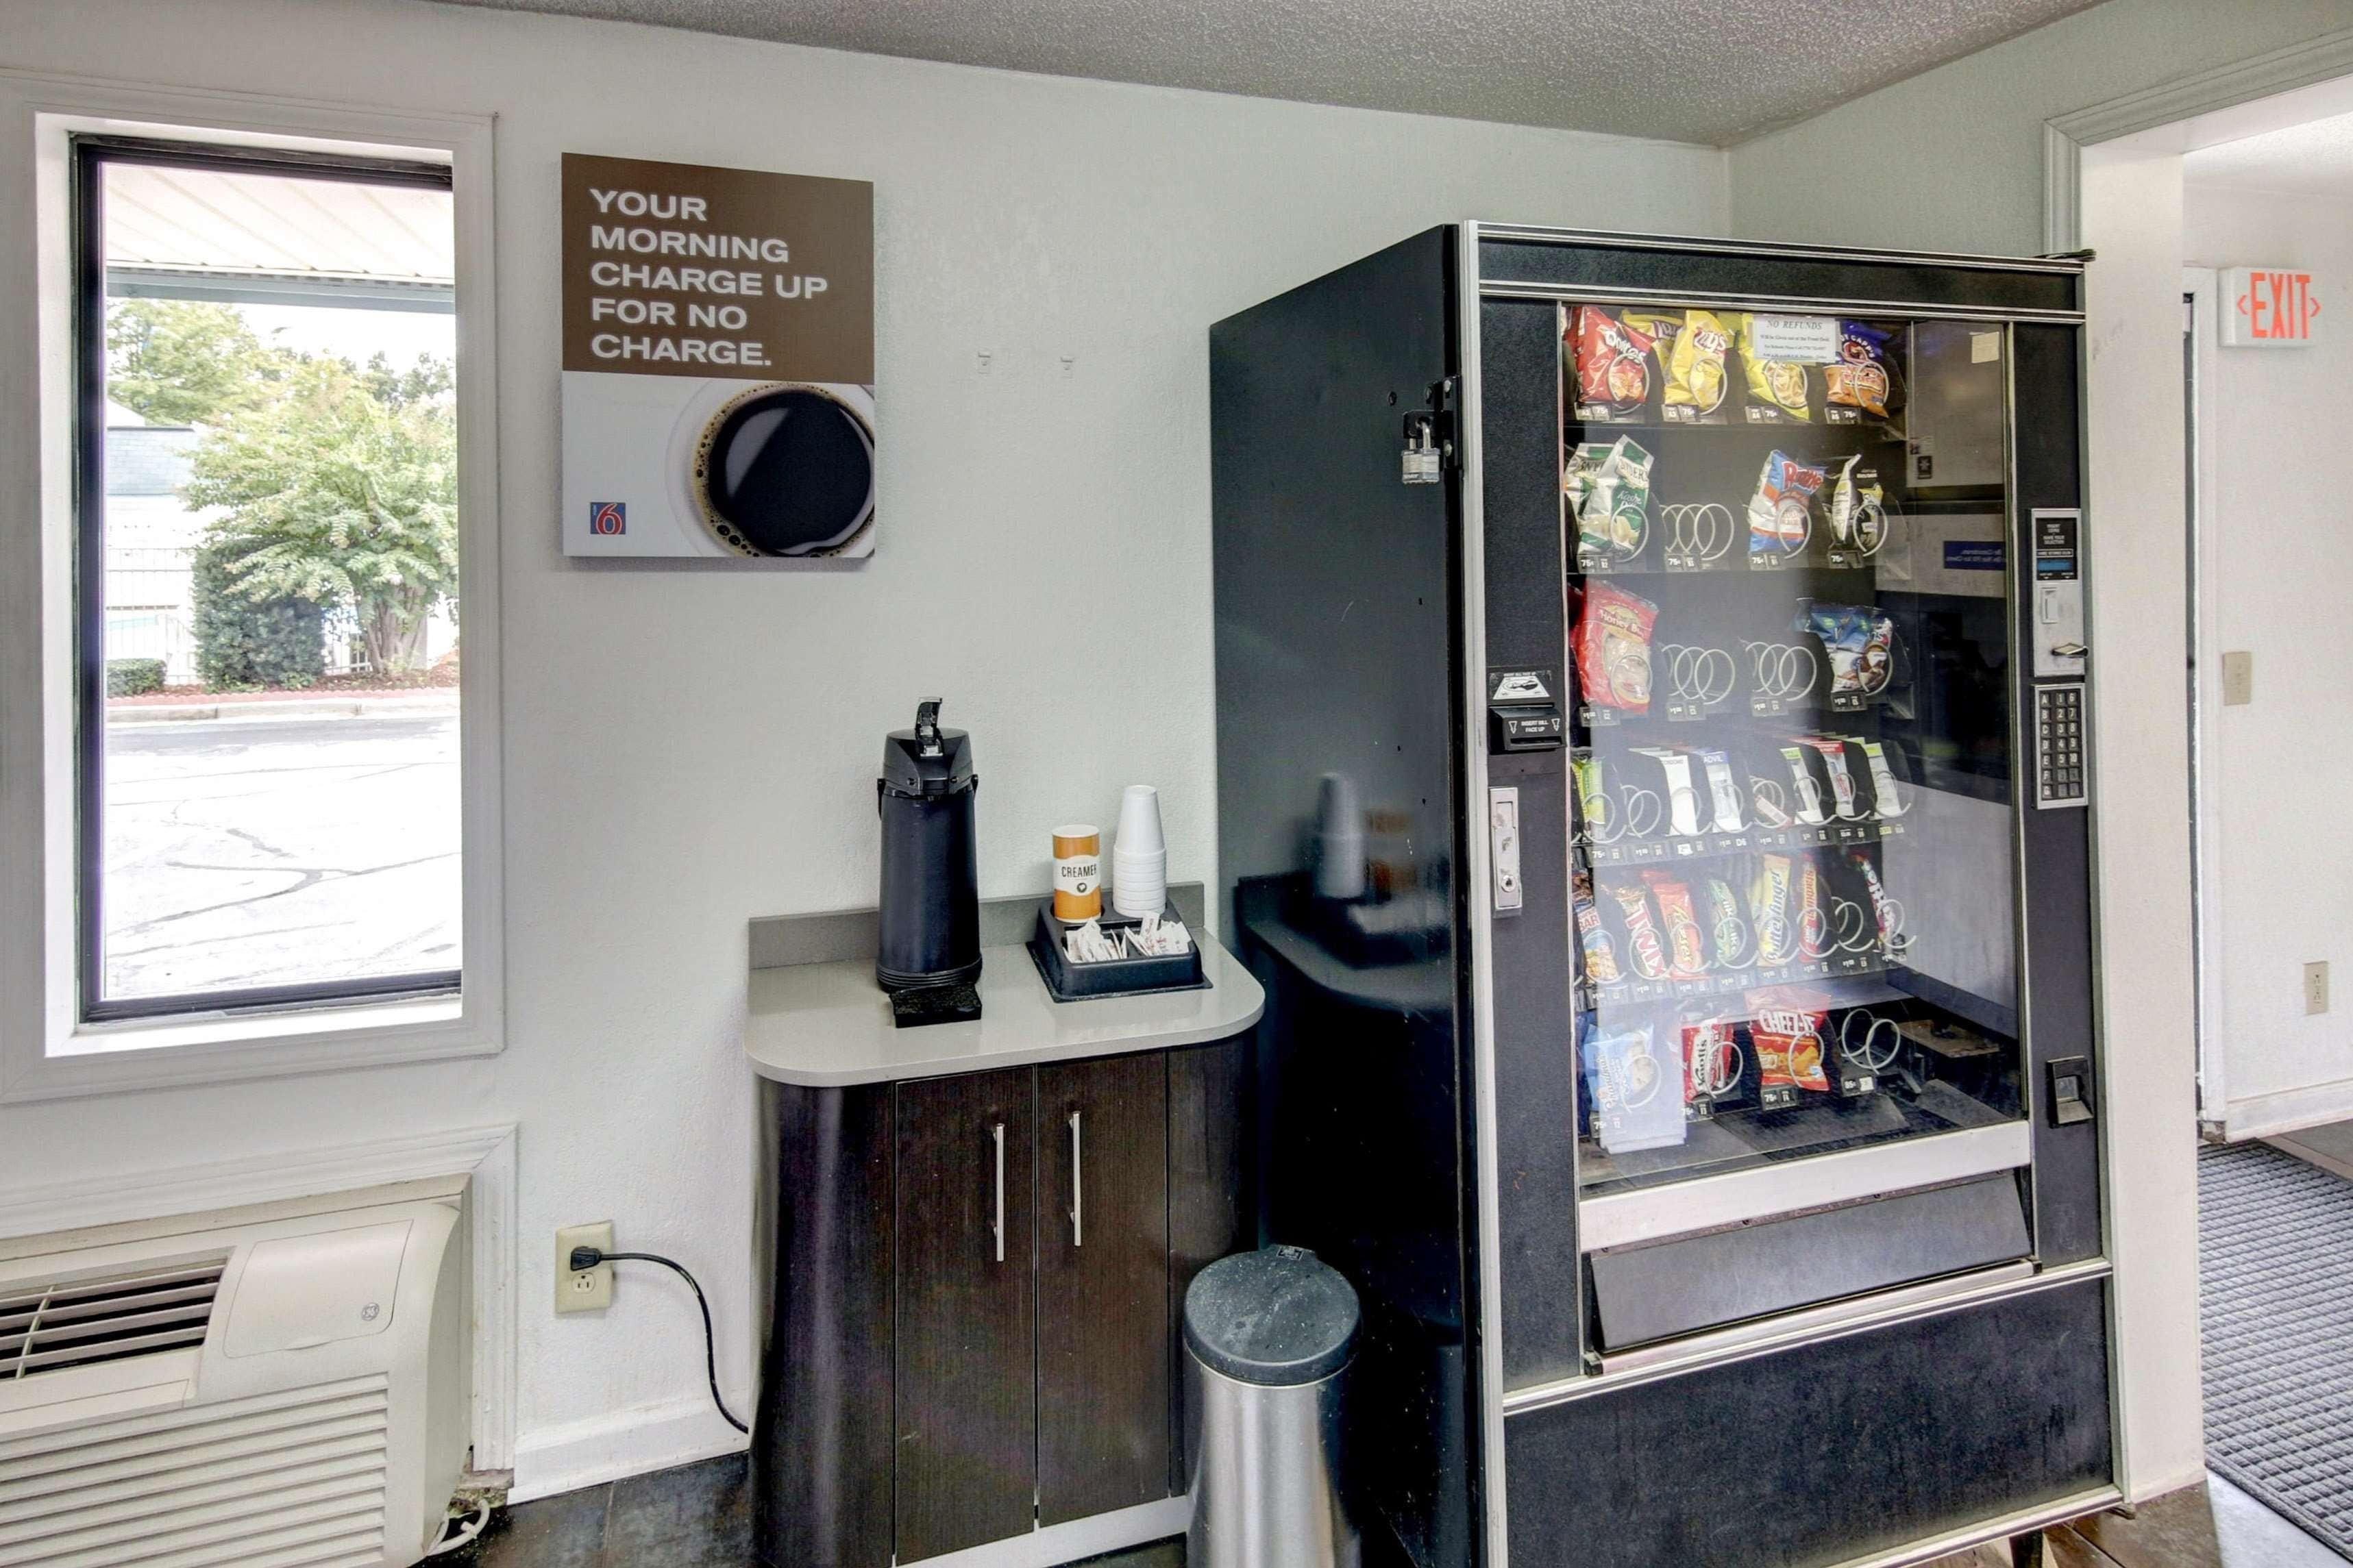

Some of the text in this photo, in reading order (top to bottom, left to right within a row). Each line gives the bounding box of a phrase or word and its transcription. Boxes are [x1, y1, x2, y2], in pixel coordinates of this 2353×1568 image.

[589, 188, 707, 221] YOUR
[591, 225, 789, 263] MORNING
[591, 262, 828, 299] CHARGE UP
[591, 298, 747, 330] FOR NO
[2250, 273, 2311, 339] EXIT
[1766, 320, 1823, 330] NO REFUNDS
[591, 334, 771, 366] CHARGE.
[1604, 329, 1647, 363] Doritos
[596, 503, 621, 536] 6
[2043, 725, 2049, 734] C
[2058, 741, 2063, 749] 4
[2043, 756, 2048, 764] E
[2044, 771, 2049, 780] F
[2059, 756, 2064, 764] 5
